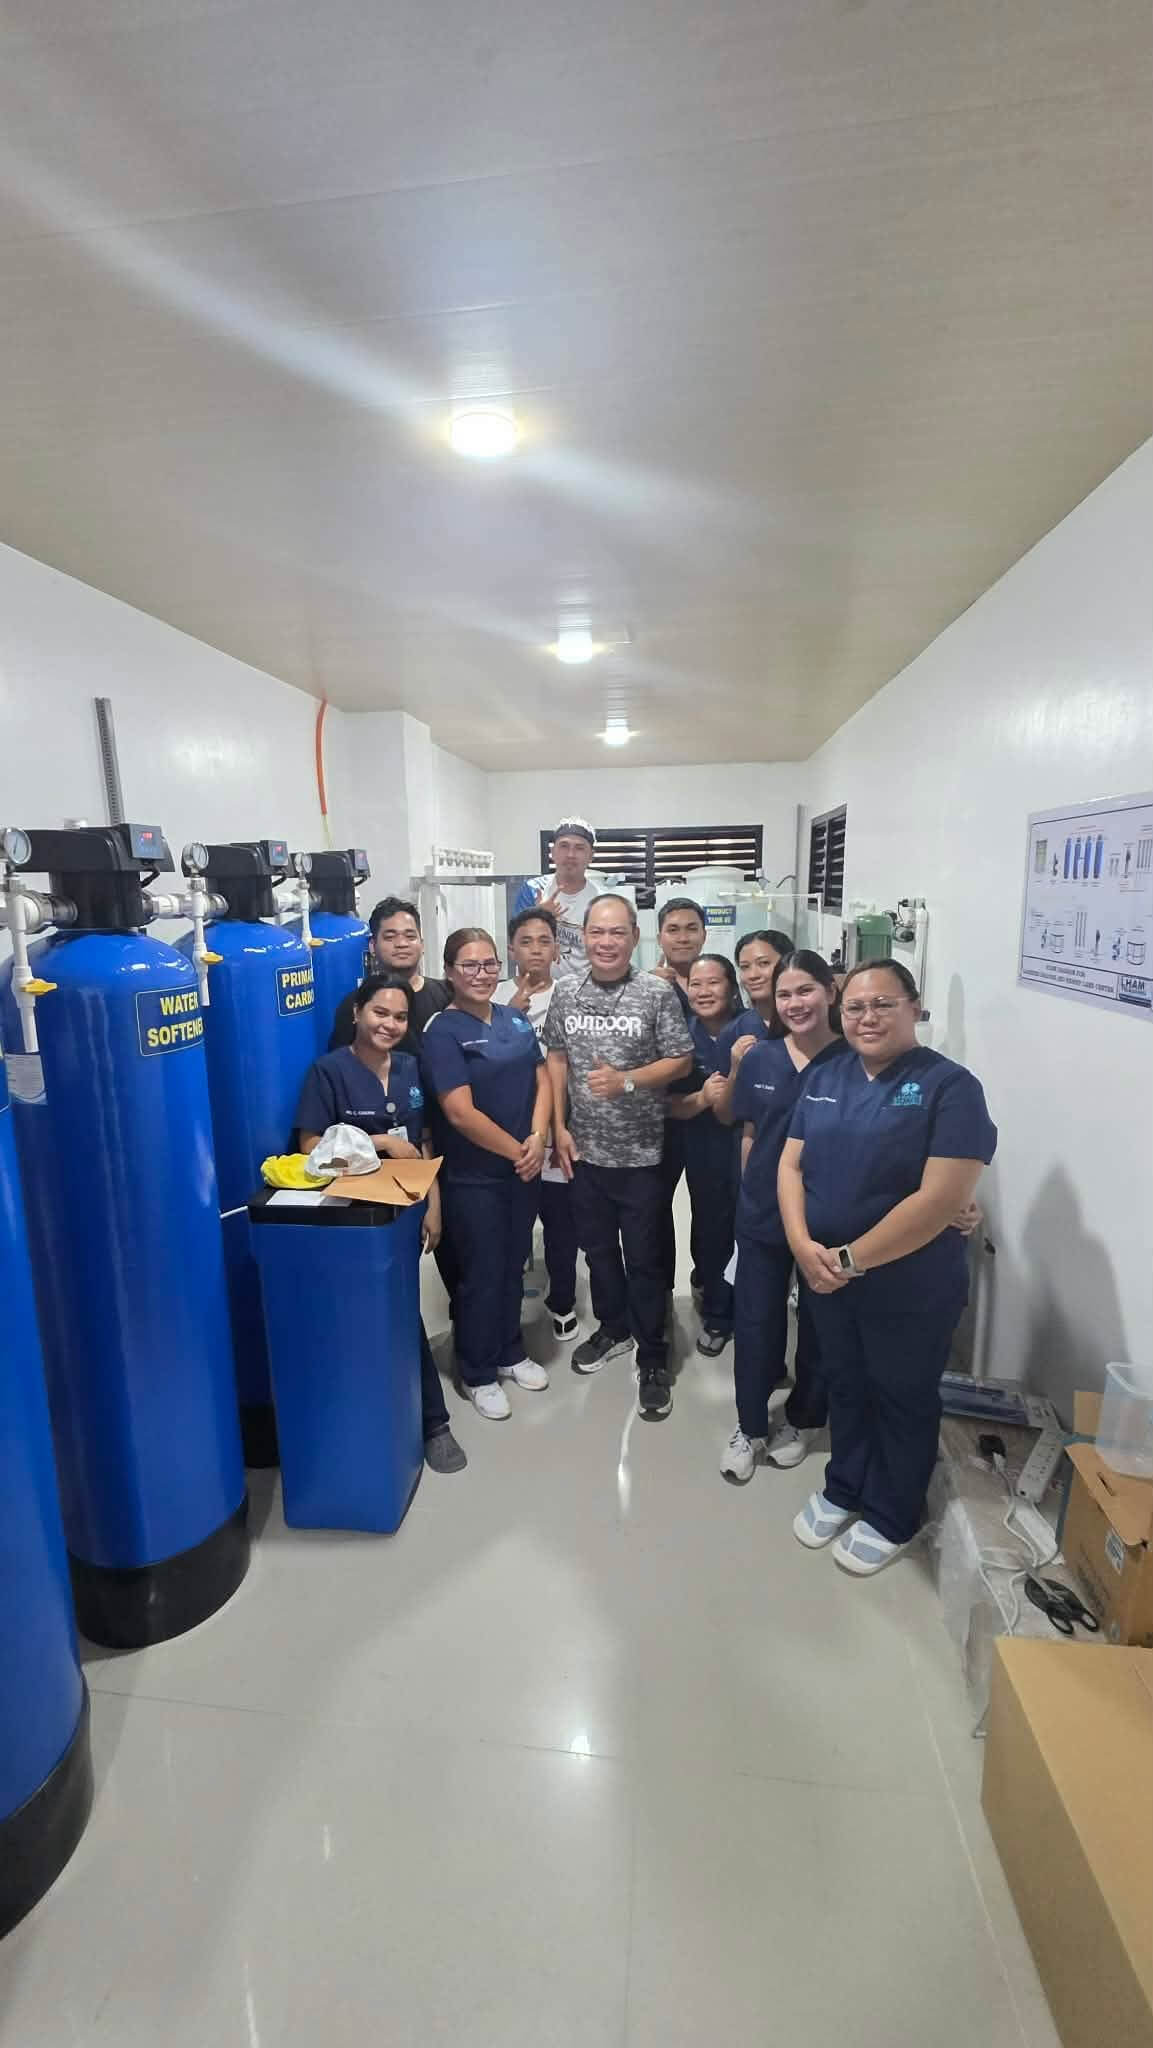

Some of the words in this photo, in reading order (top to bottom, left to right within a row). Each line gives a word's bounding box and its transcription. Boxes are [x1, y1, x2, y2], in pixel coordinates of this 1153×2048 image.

[281, 968, 314, 988] PRIMA
[160, 991, 198, 1016] WATER
[147, 1016, 203, 1047] SOFTENE
[565, 1015, 641, 1037] OUTDOOR
